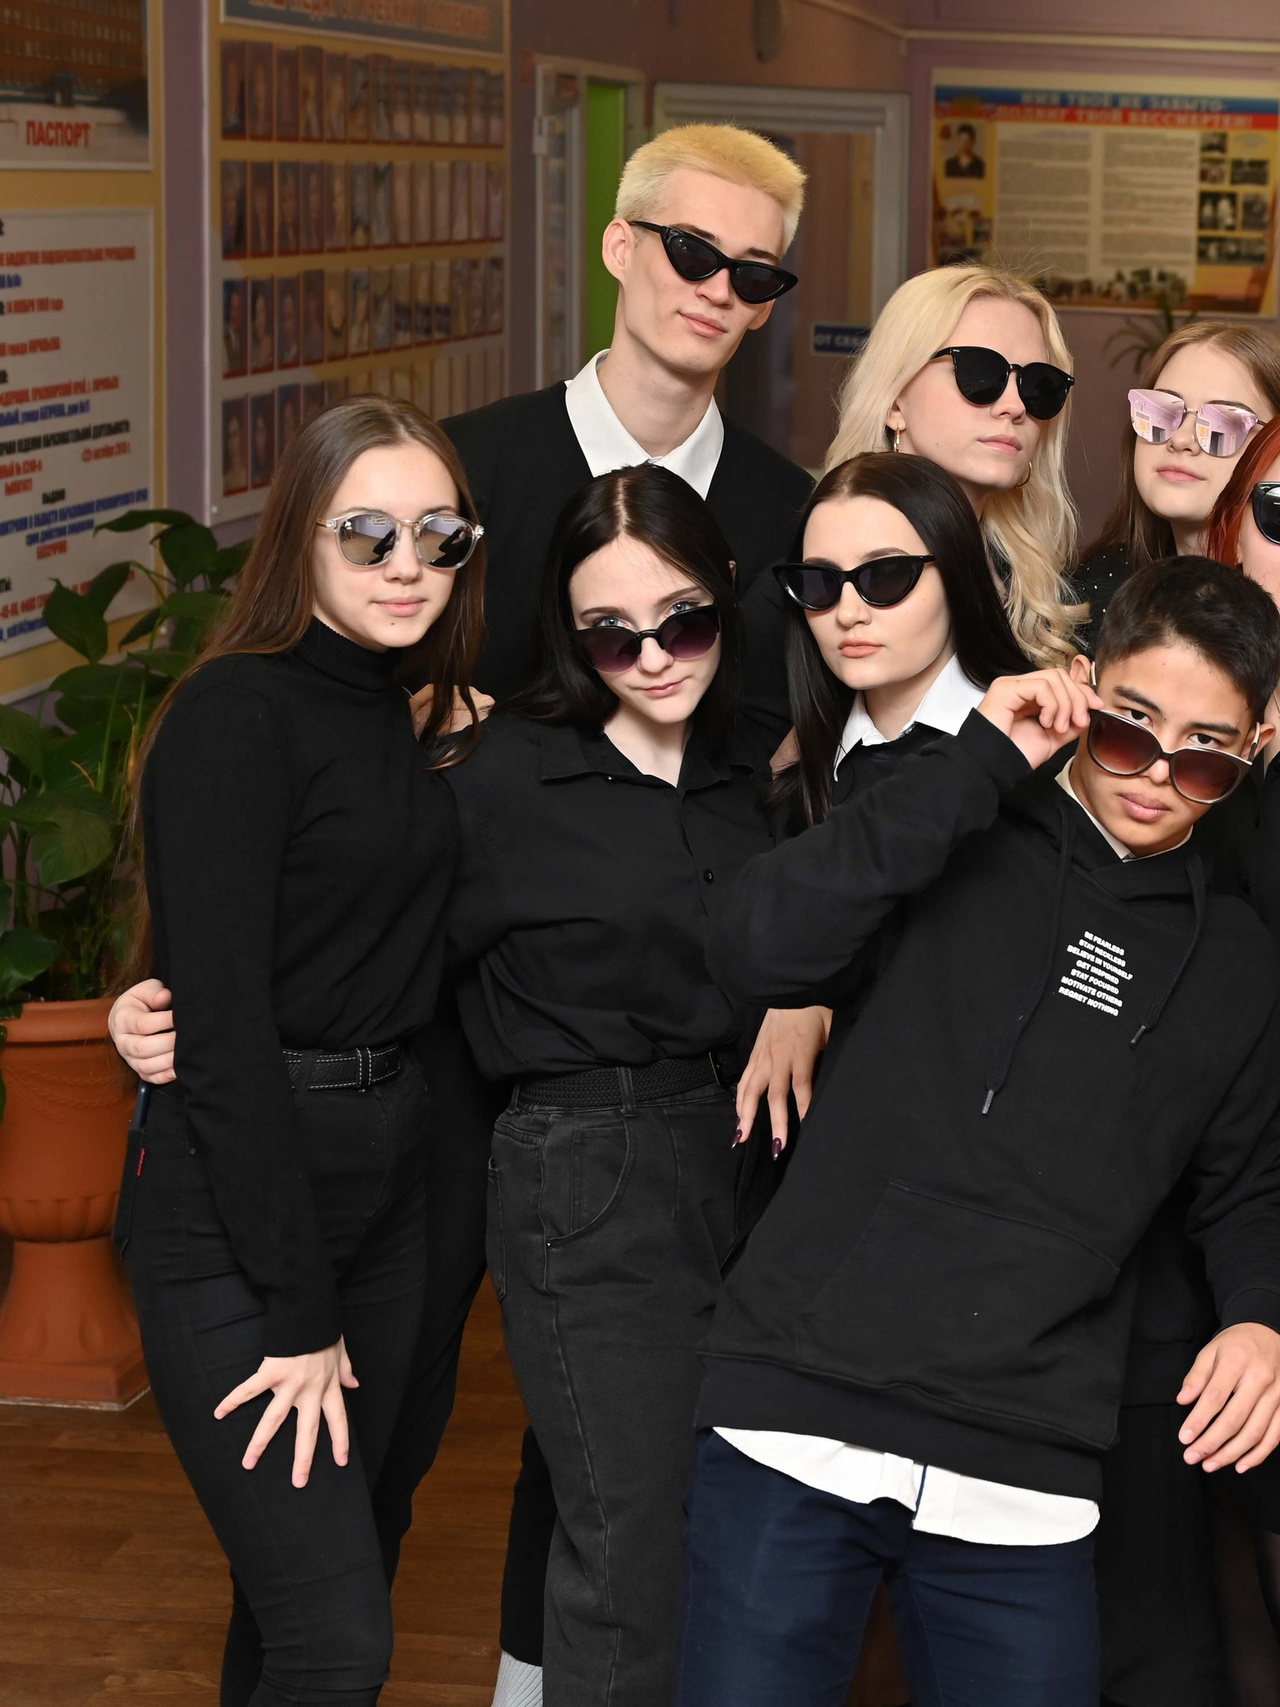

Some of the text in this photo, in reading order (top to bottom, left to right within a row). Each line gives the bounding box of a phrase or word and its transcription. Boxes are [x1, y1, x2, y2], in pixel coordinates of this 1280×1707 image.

[26, 120, 91, 147] ПАСПОРТ
[1079, 939, 1126, 967] STAY RECKLESS
[1093, 936, 1125, 956] FEARLESS
[1067, 945, 1133, 980] BELIEVE IN YOURSELF
[1076, 960, 1119, 984] GET INSPIRED
[1061, 976, 1122, 1007] MOTIVATE OTHERS
[1071, 969, 1119, 994] STAY FOCUSED
[1058, 987, 1119, 1016] REGRET NOTHING
